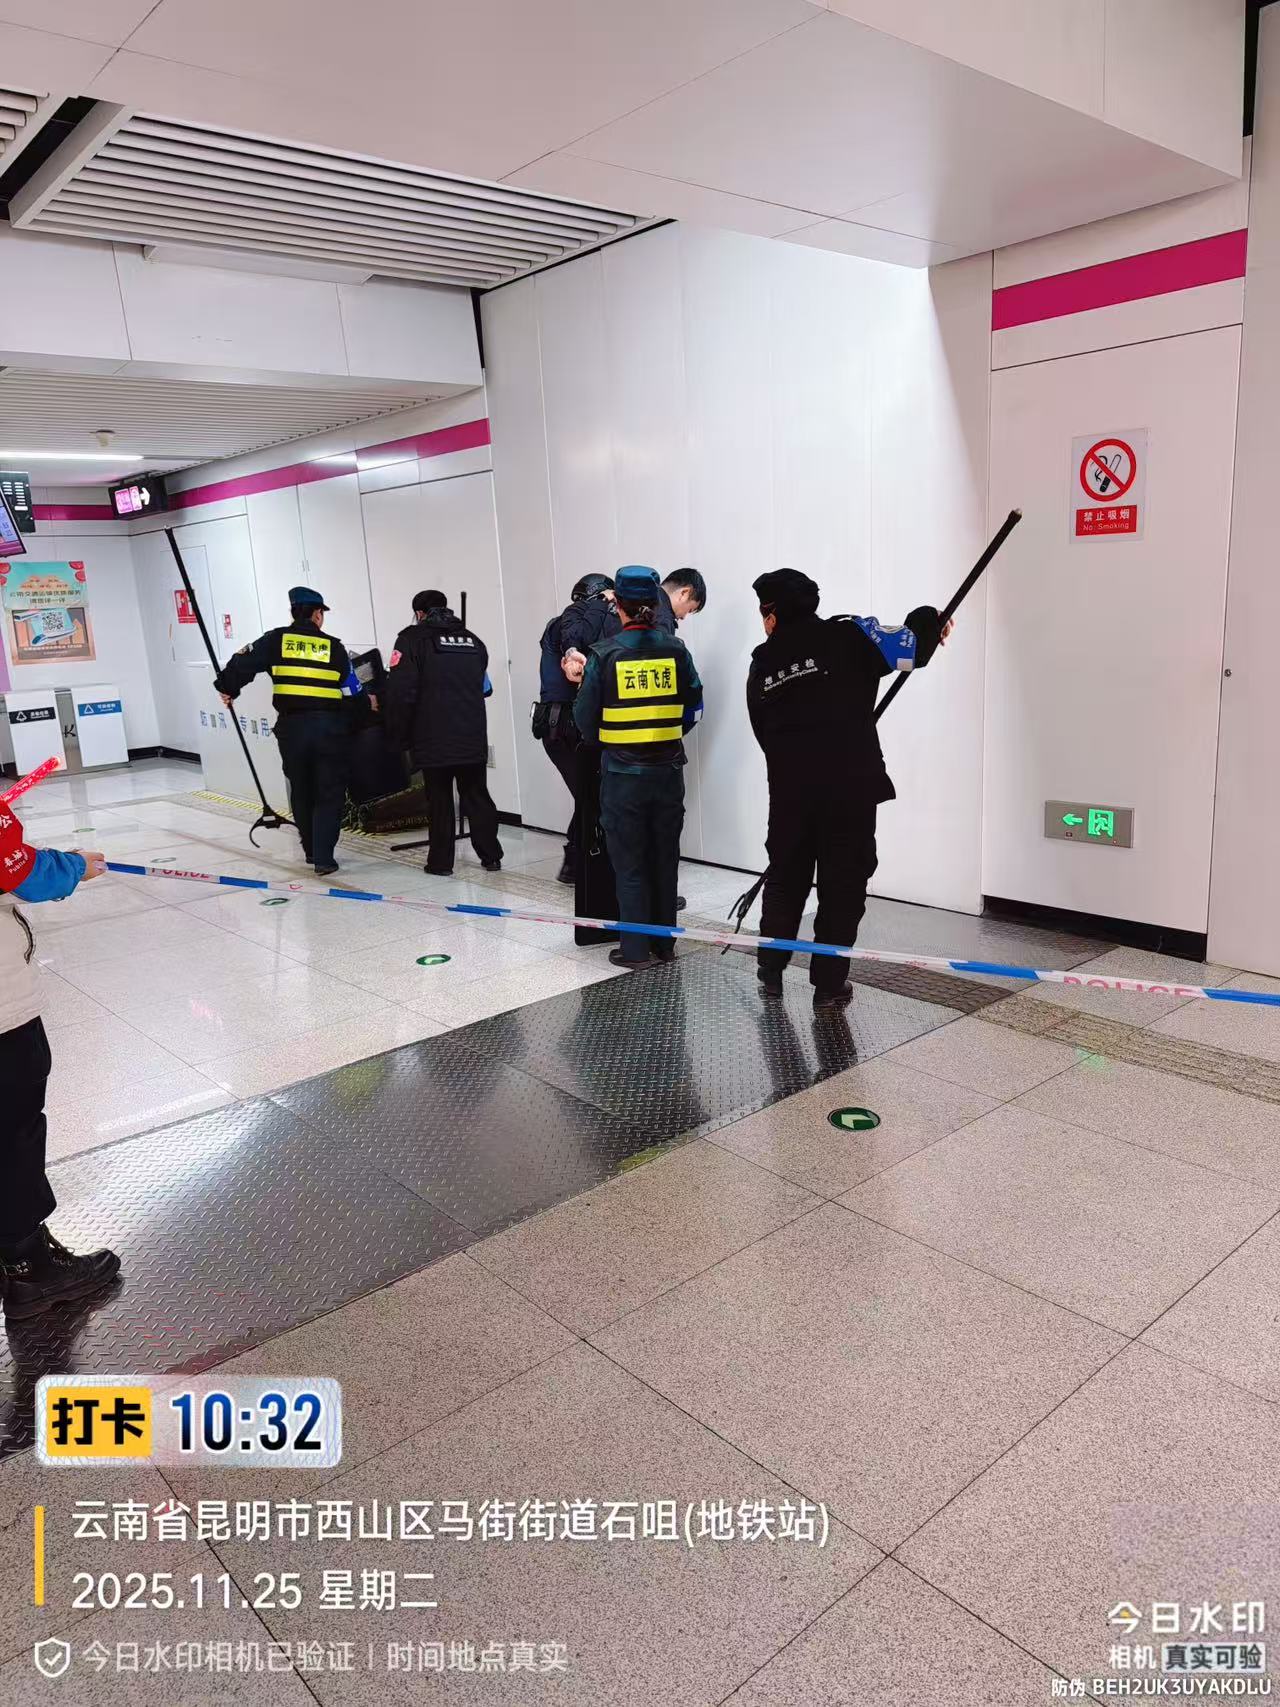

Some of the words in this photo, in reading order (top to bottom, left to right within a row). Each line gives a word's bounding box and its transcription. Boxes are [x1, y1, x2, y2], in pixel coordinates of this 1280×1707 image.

[1084, 508, 1130, 521] 禁止吸烟
[1098, 522, 1130, 530] Smoking
[285, 639, 329, 653] 云南飞虎
[624, 668, 672, 690] 云南飞虎
